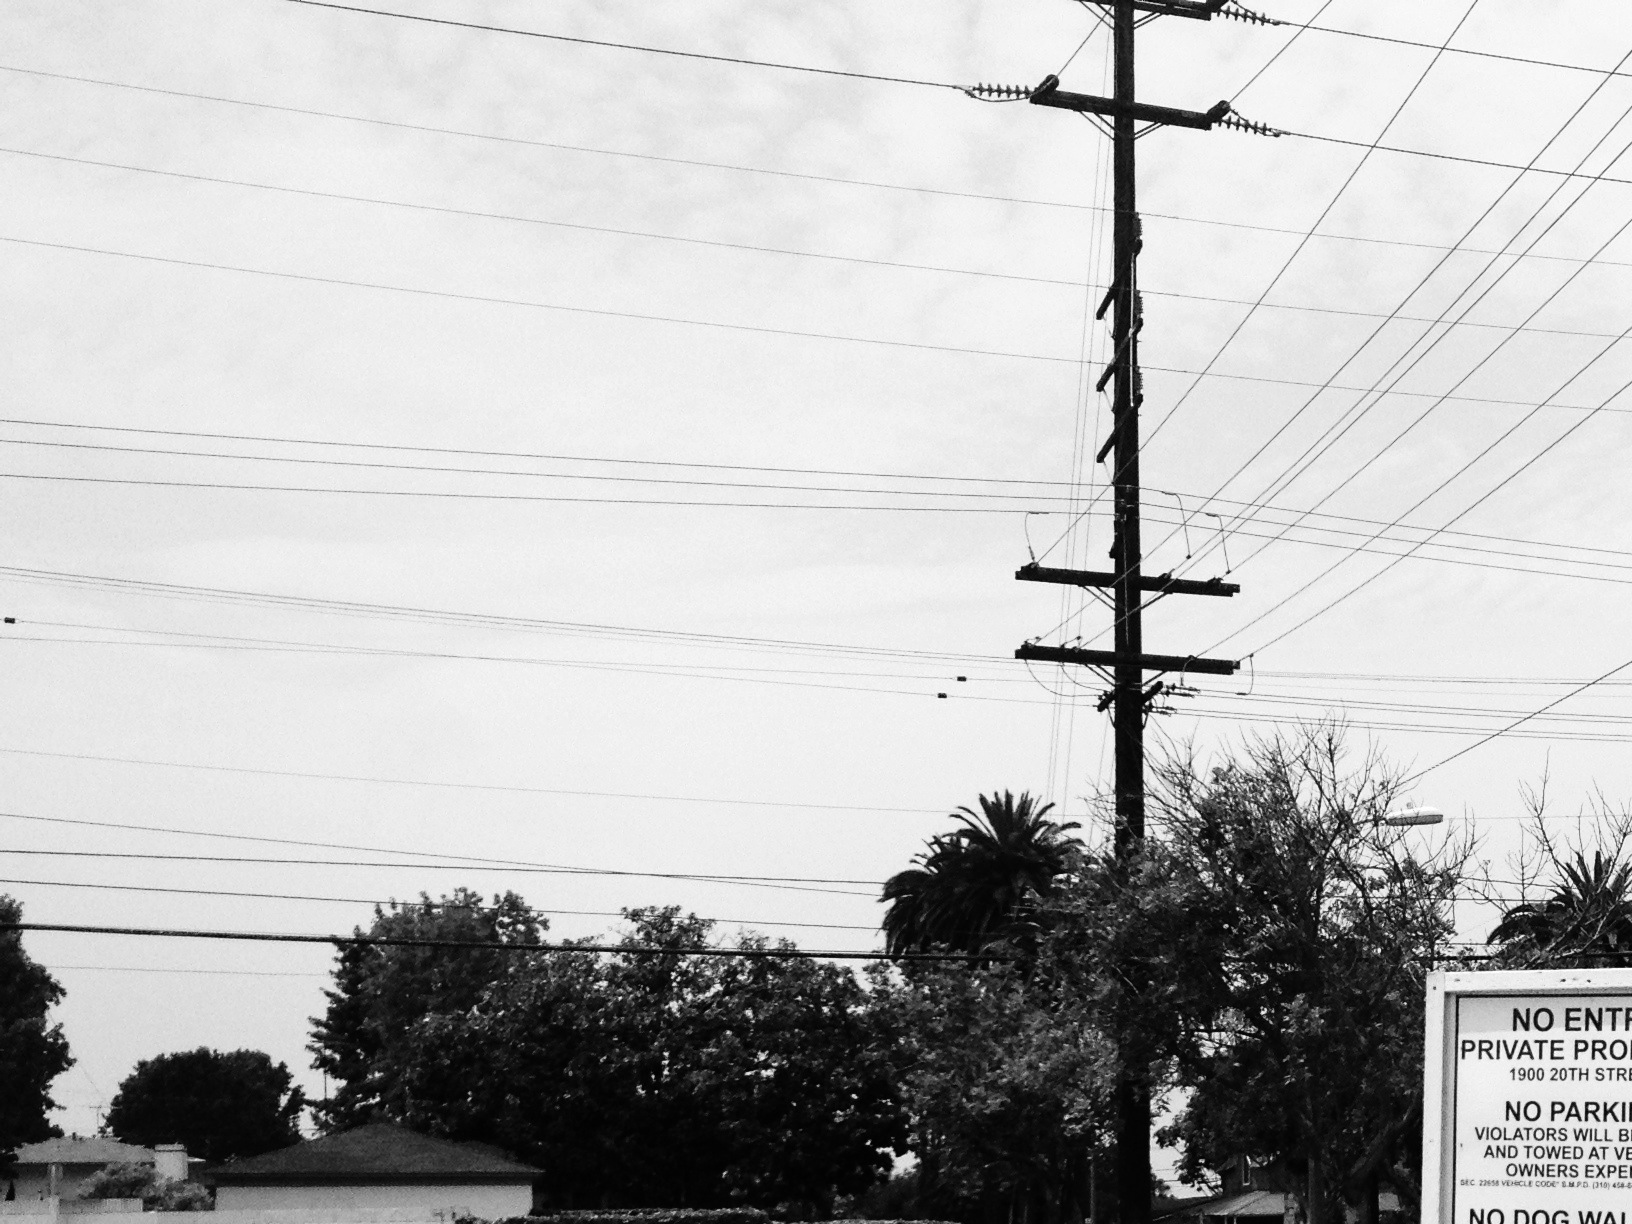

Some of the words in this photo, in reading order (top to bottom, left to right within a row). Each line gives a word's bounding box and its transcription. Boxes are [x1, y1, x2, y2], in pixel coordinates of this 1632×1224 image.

[1512, 1007, 1554, 1032] NO
[1461, 1039, 1565, 1060] PRIVATE
[1509, 1068, 1545, 1081] 1900
[1550, 1068, 1590, 1081] 20TH
[1505, 1101, 1542, 1122] NO
[1474, 1127, 1568, 1141] VIOLATORS
[1573, 1128, 1613, 1142] WILL
[1483, 1145, 1519, 1159] AND
[1523, 1146, 1584, 1160] TOWED
[1588, 1147, 1609, 1160] AT
[1505, 1163, 1579, 1178] OWNERS
[1501, 1180, 1533, 1188] VEHICLE
